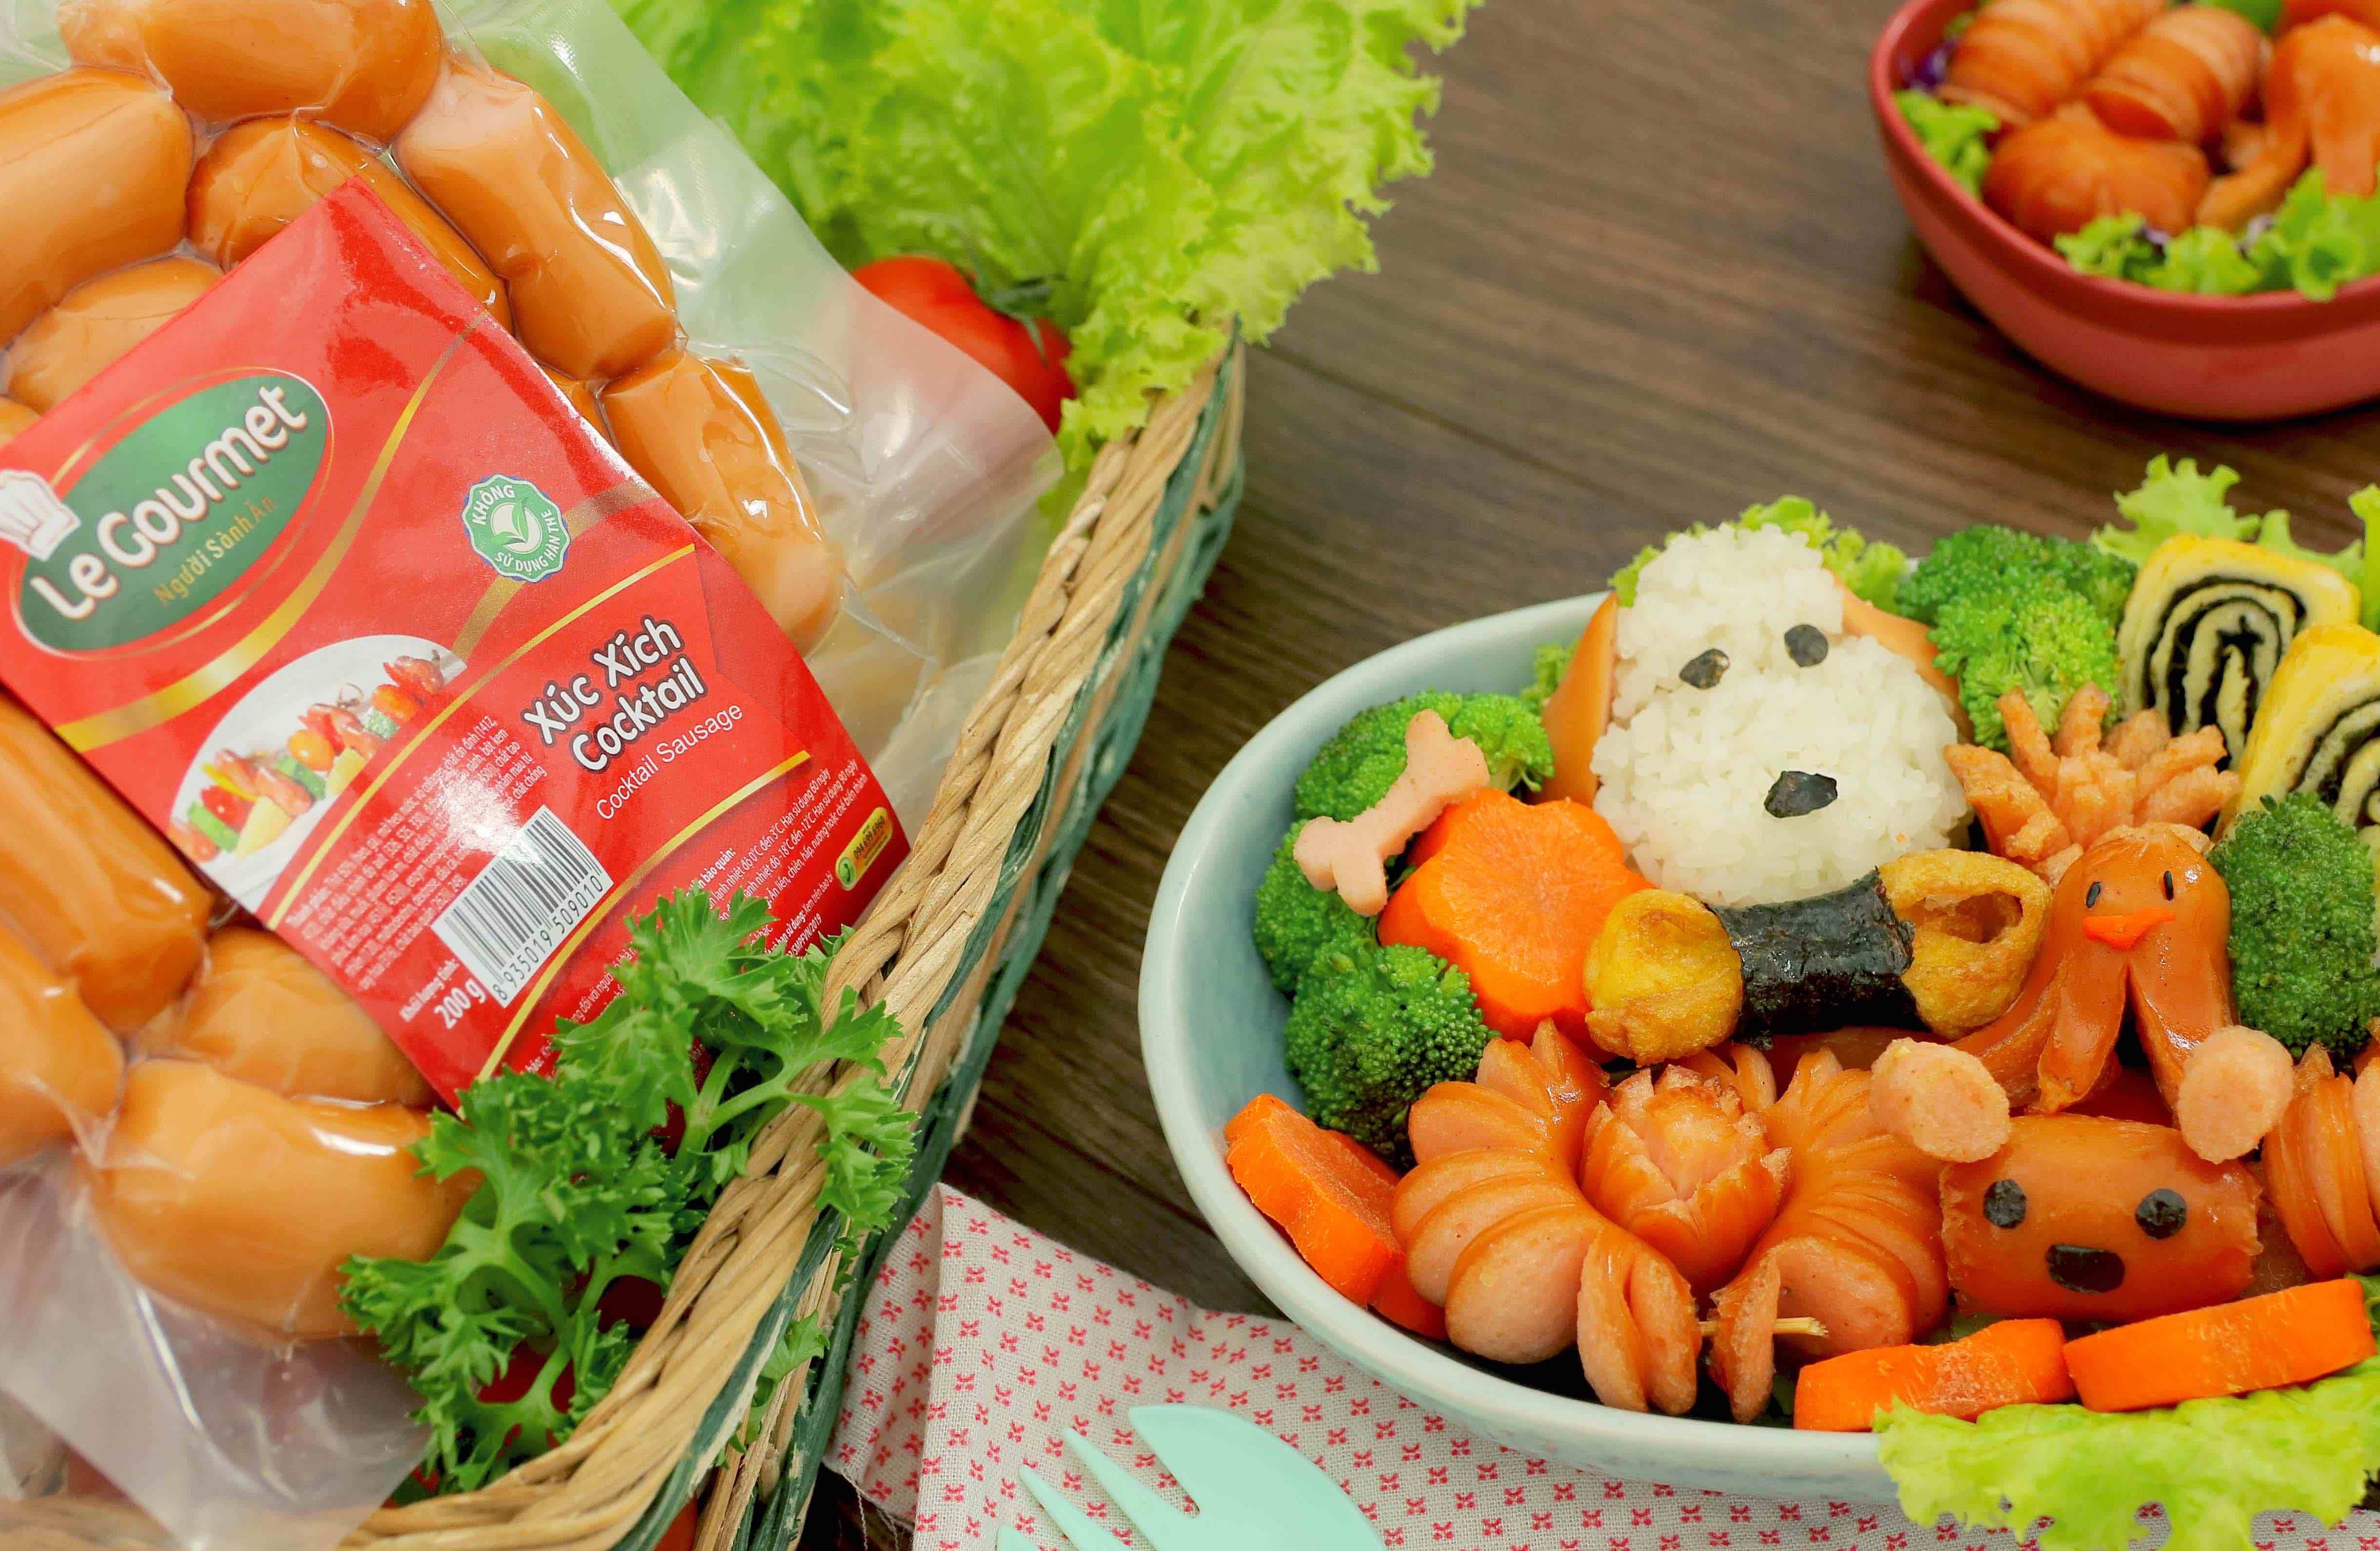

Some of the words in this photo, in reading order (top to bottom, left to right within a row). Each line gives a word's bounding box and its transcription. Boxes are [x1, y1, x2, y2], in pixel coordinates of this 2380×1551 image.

[30, 552, 119, 620] Le
[95, 385, 308, 570] Gourmet
[471, 484, 516, 525] KHÔNG
[153, 549, 212, 607] Người
[206, 515, 254, 559] Sành
[494, 551, 514, 567] SỬ
[515, 555, 548, 576] DỤNG
[540, 508, 560, 533] THE
[522, 673, 602, 747] Xúc
[592, 616, 683, 690] Xích
[570, 656, 706, 773] Cocktail
[489, 729, 509, 746] kem
[492, 748, 512, 767] chất
[505, 741, 520, 755] tạo
[510, 760, 527, 777] màu
[511, 781, 529, 799] chất
[523, 761, 548, 787] chống
[596, 753, 659, 820] Cocktail
[656, 705, 743, 763] Sausage
[709, 882, 730, 901] lạnh
[726, 866, 746, 887] nhiệt
[740, 856, 754, 870] độ
[759, 835, 775, 851] đến
[779, 812, 795, 828] Hạn
[792, 802, 801, 816] sử
[797, 789, 815, 809] dụng
[809, 780, 819, 794] 60
[816, 768, 831, 786] ngày
[755, 864, 773, 885] nhiệt
[769, 855, 782, 869] độ
[790, 829, 804, 845] đến
[812, 802, 826, 818] Hạn
[826, 780, 843, 799] dụng
[838, 771, 849, 784] 90
[700, 867, 718, 883] bảo
[715, 847, 736, 870] quản:
[818, 878, 830, 893] bao
[801, 899, 815, 915] Xem
[811, 888, 822, 903] trên
[492, 984, 509, 1001] 8
[503, 929, 560, 988] 935019
[546, 875, 610, 935] 509010
[786, 923, 796, 937] sử
[789, 910, 806, 930] dụng:
[434, 987, 471, 1030] 200
[465, 978, 486, 1003] g
